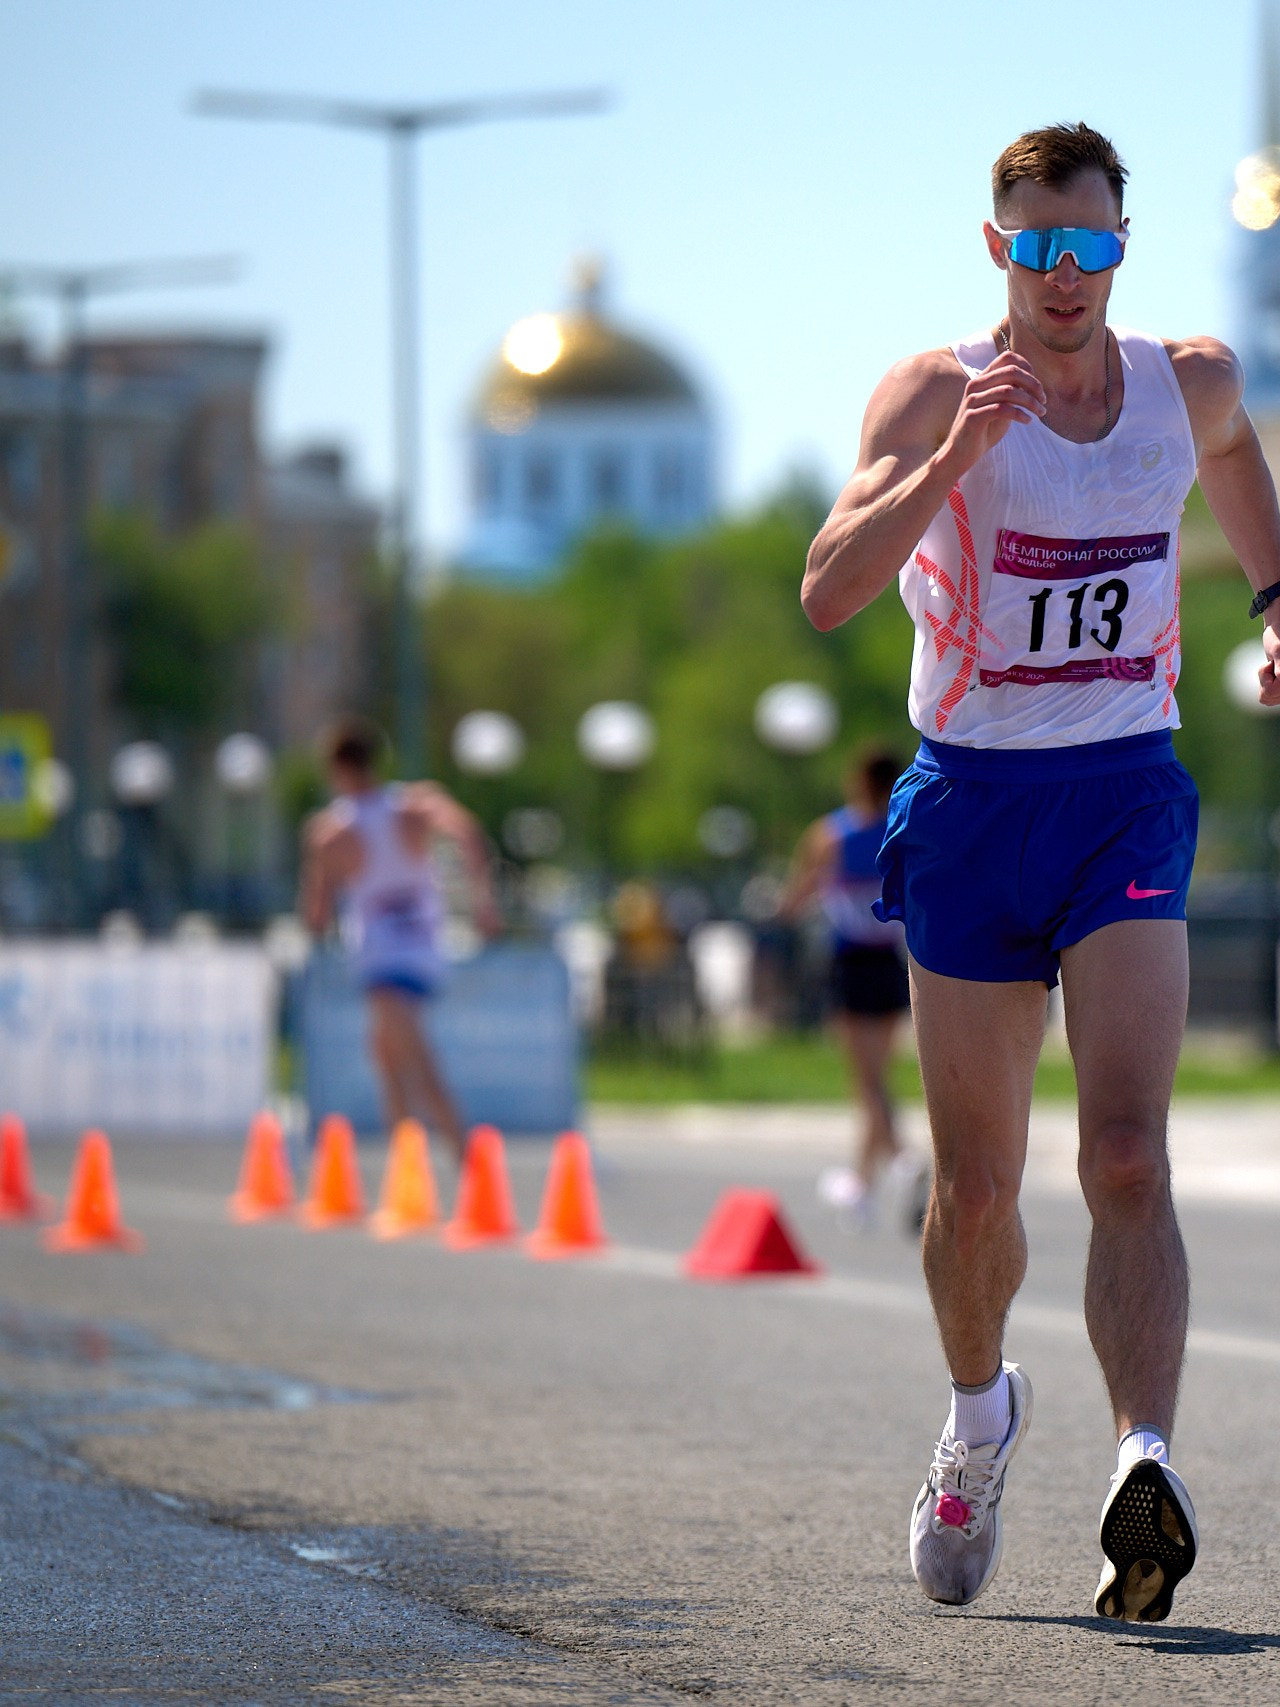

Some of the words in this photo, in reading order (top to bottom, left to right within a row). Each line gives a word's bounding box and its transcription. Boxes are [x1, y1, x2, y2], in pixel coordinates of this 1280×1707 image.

[1002, 541, 1092, 562] ЧЕМПИОНАТ
[1098, 544, 1157, 560] РОССИИ
[1002, 553, 1015, 562] по
[1017, 555, 1056, 569] ходьбе
[1027, 578, 1129, 653] 113
[1025, 672, 1046, 680] 2025
